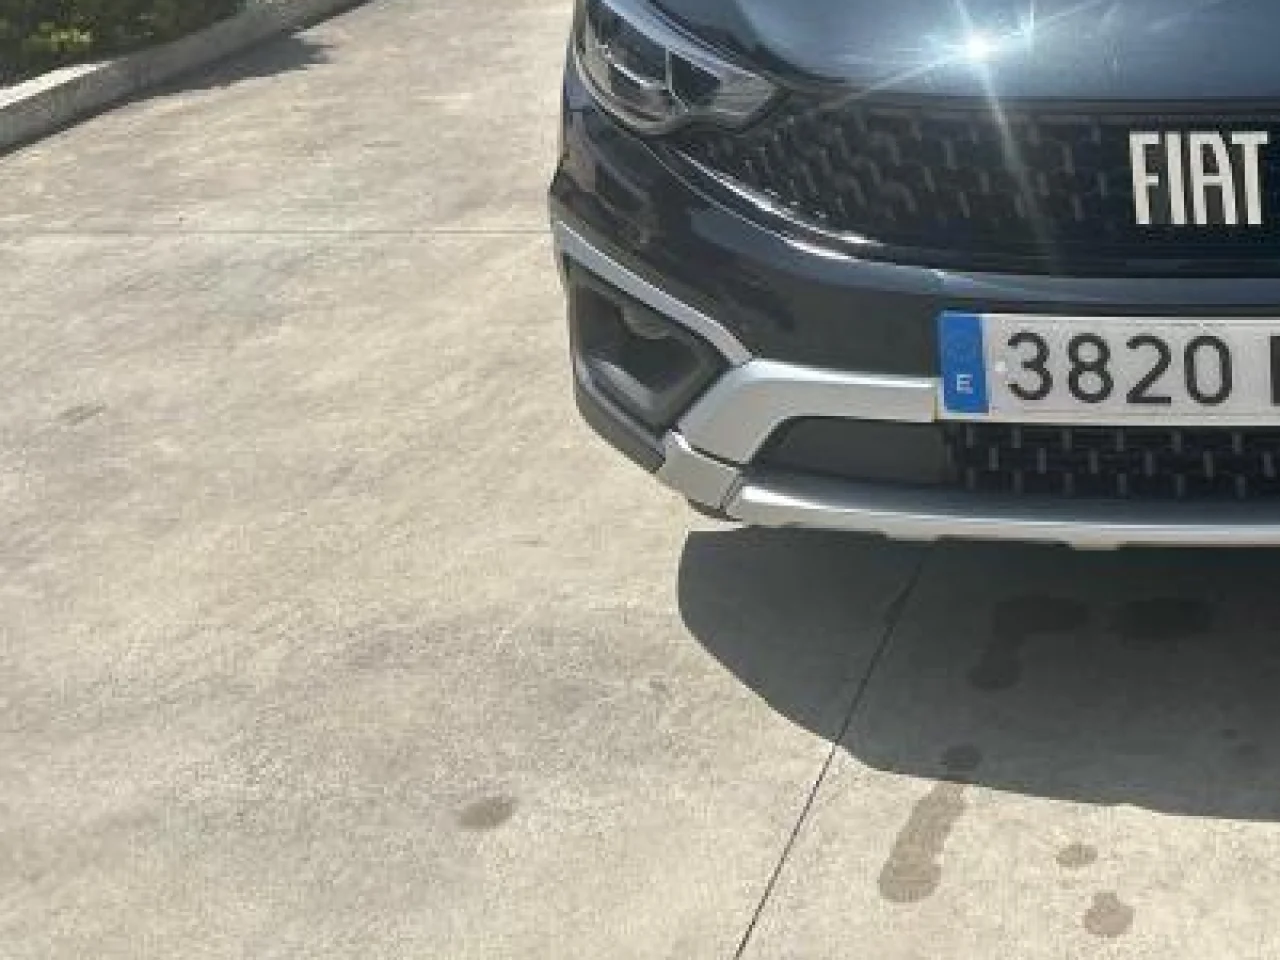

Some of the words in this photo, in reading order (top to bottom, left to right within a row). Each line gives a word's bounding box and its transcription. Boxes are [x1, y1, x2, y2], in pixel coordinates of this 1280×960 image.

[1130, 130, 1269, 225] FIAT
[956, 373, 974, 394] E
[1007, 332, 1233, 407] 3820
